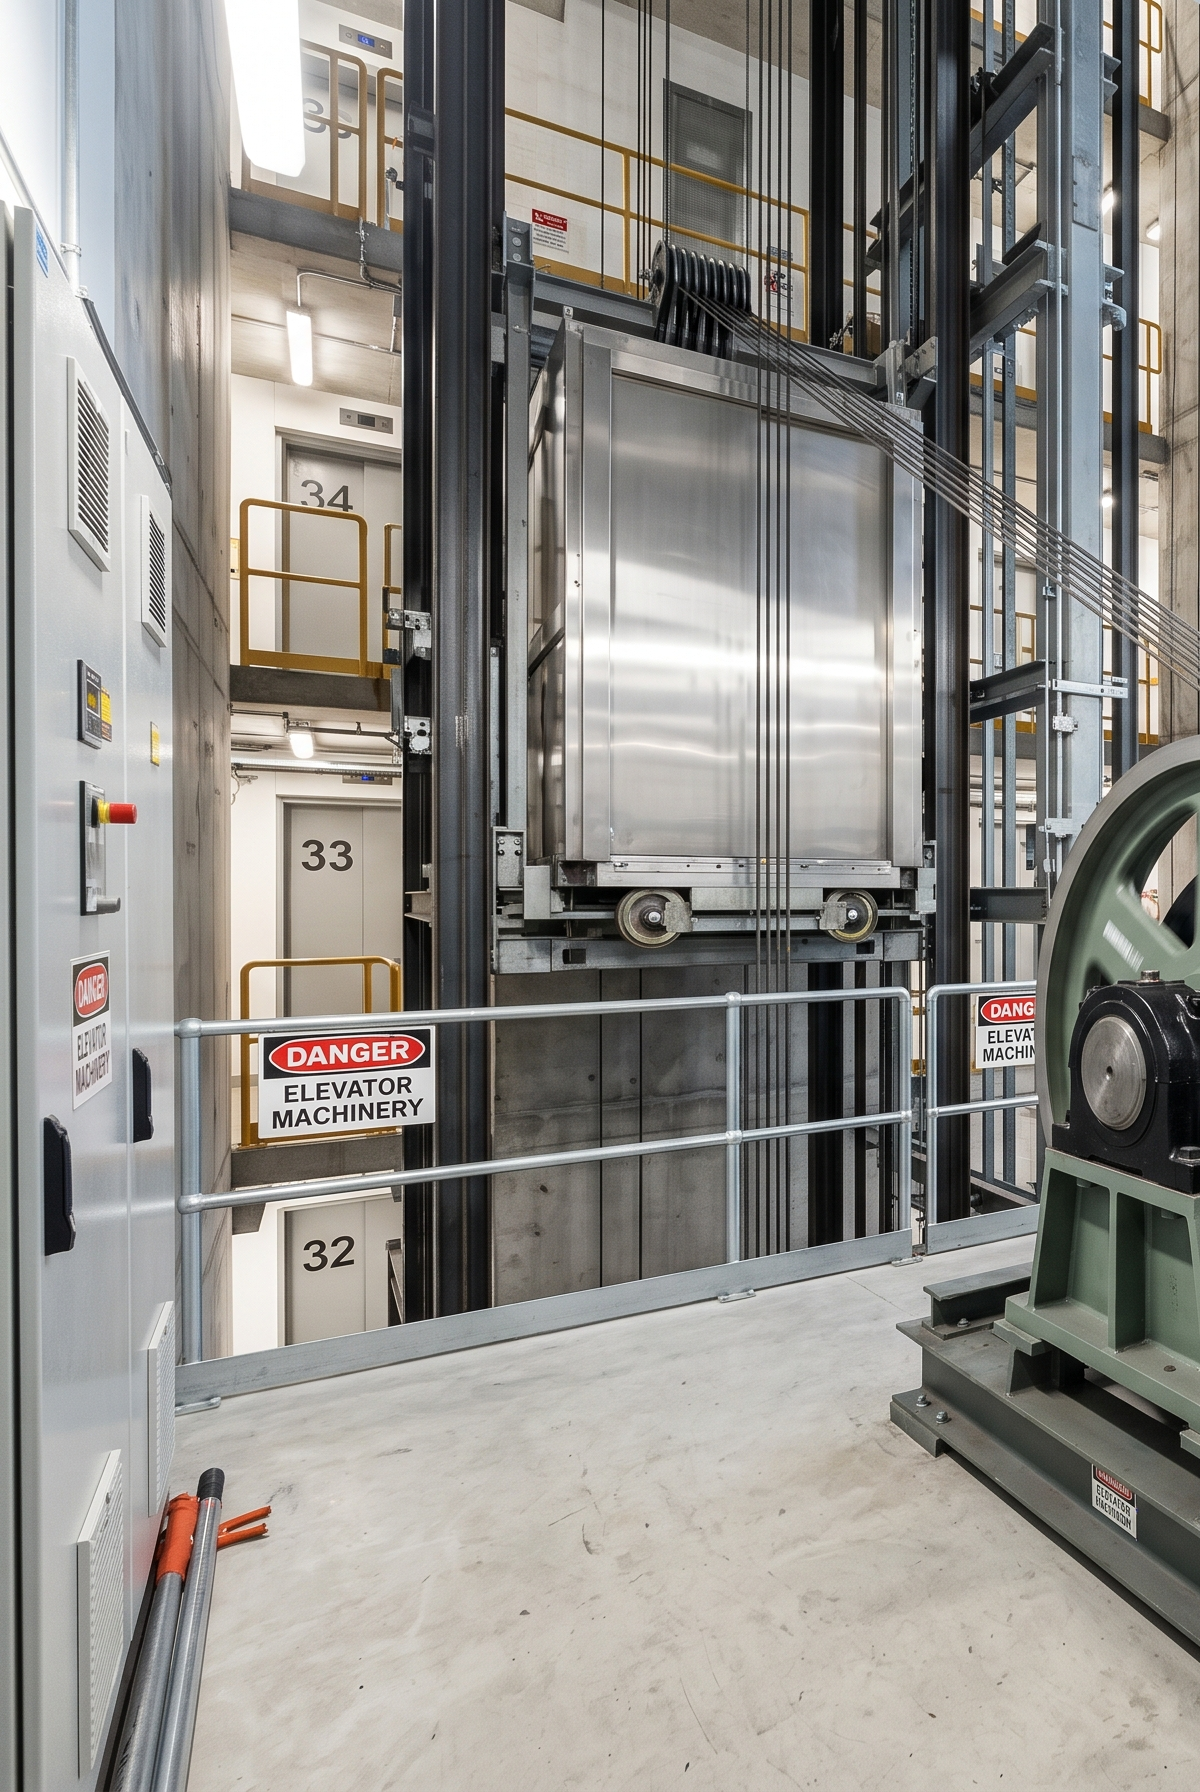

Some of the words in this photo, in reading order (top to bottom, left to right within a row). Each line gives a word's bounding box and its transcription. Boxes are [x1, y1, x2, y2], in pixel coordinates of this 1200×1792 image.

[300, 479, 353, 512] 34
[301, 839, 353, 872] 33
[78, 973, 105, 1008] DANGER
[990, 1001, 1036, 1019] DANG
[287, 1040, 410, 1067] DANGER
[284, 1076, 412, 1103] ELEVATOR
[272, 1098, 424, 1129] MACHINERY
[303, 1235, 355, 1272] 32
